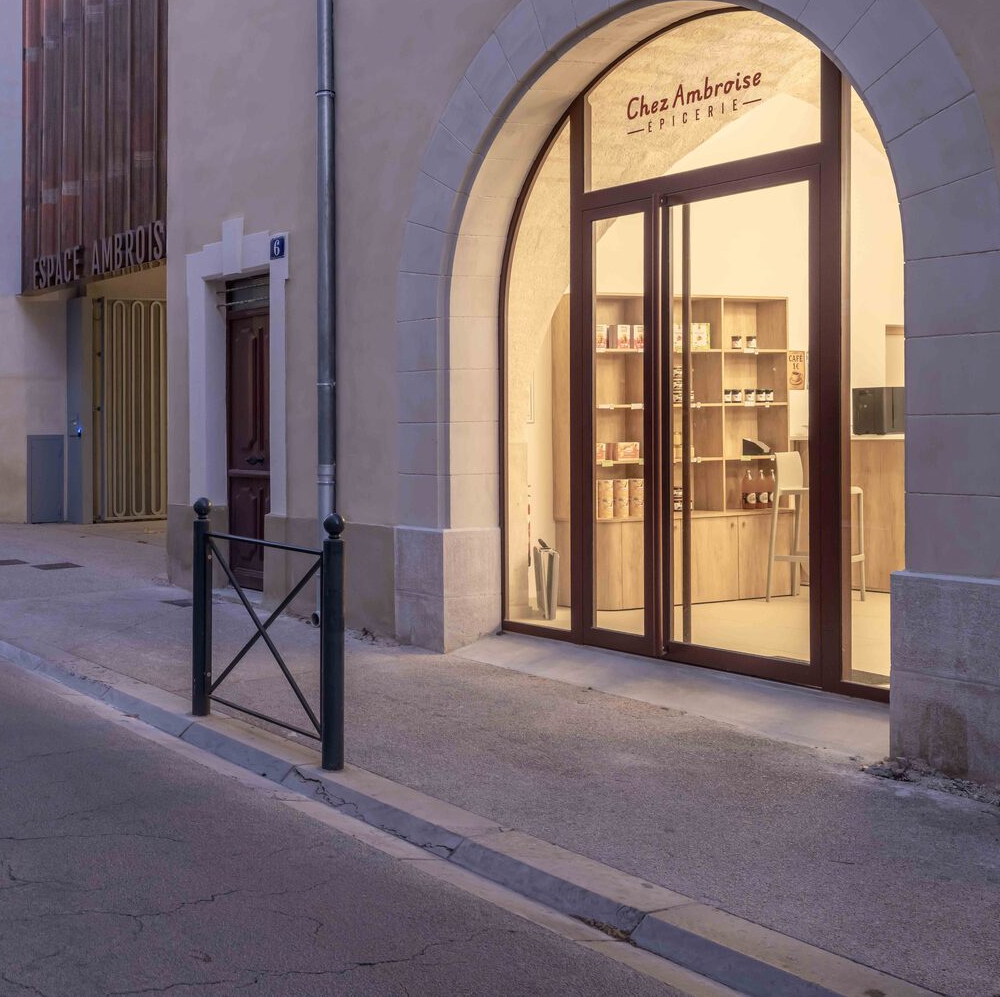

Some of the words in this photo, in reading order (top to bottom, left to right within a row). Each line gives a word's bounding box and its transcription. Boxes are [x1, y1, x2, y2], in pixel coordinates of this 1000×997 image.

[627, 95, 669, 120] Chez
[672, 72, 762, 108] Ambroise
[647, 98, 738, 133] ÉPICERIE
[33, 245, 80, 289] ESPACE
[91, 220, 166, 275] AMBROIS
[273, 239, 281, 256] 6
